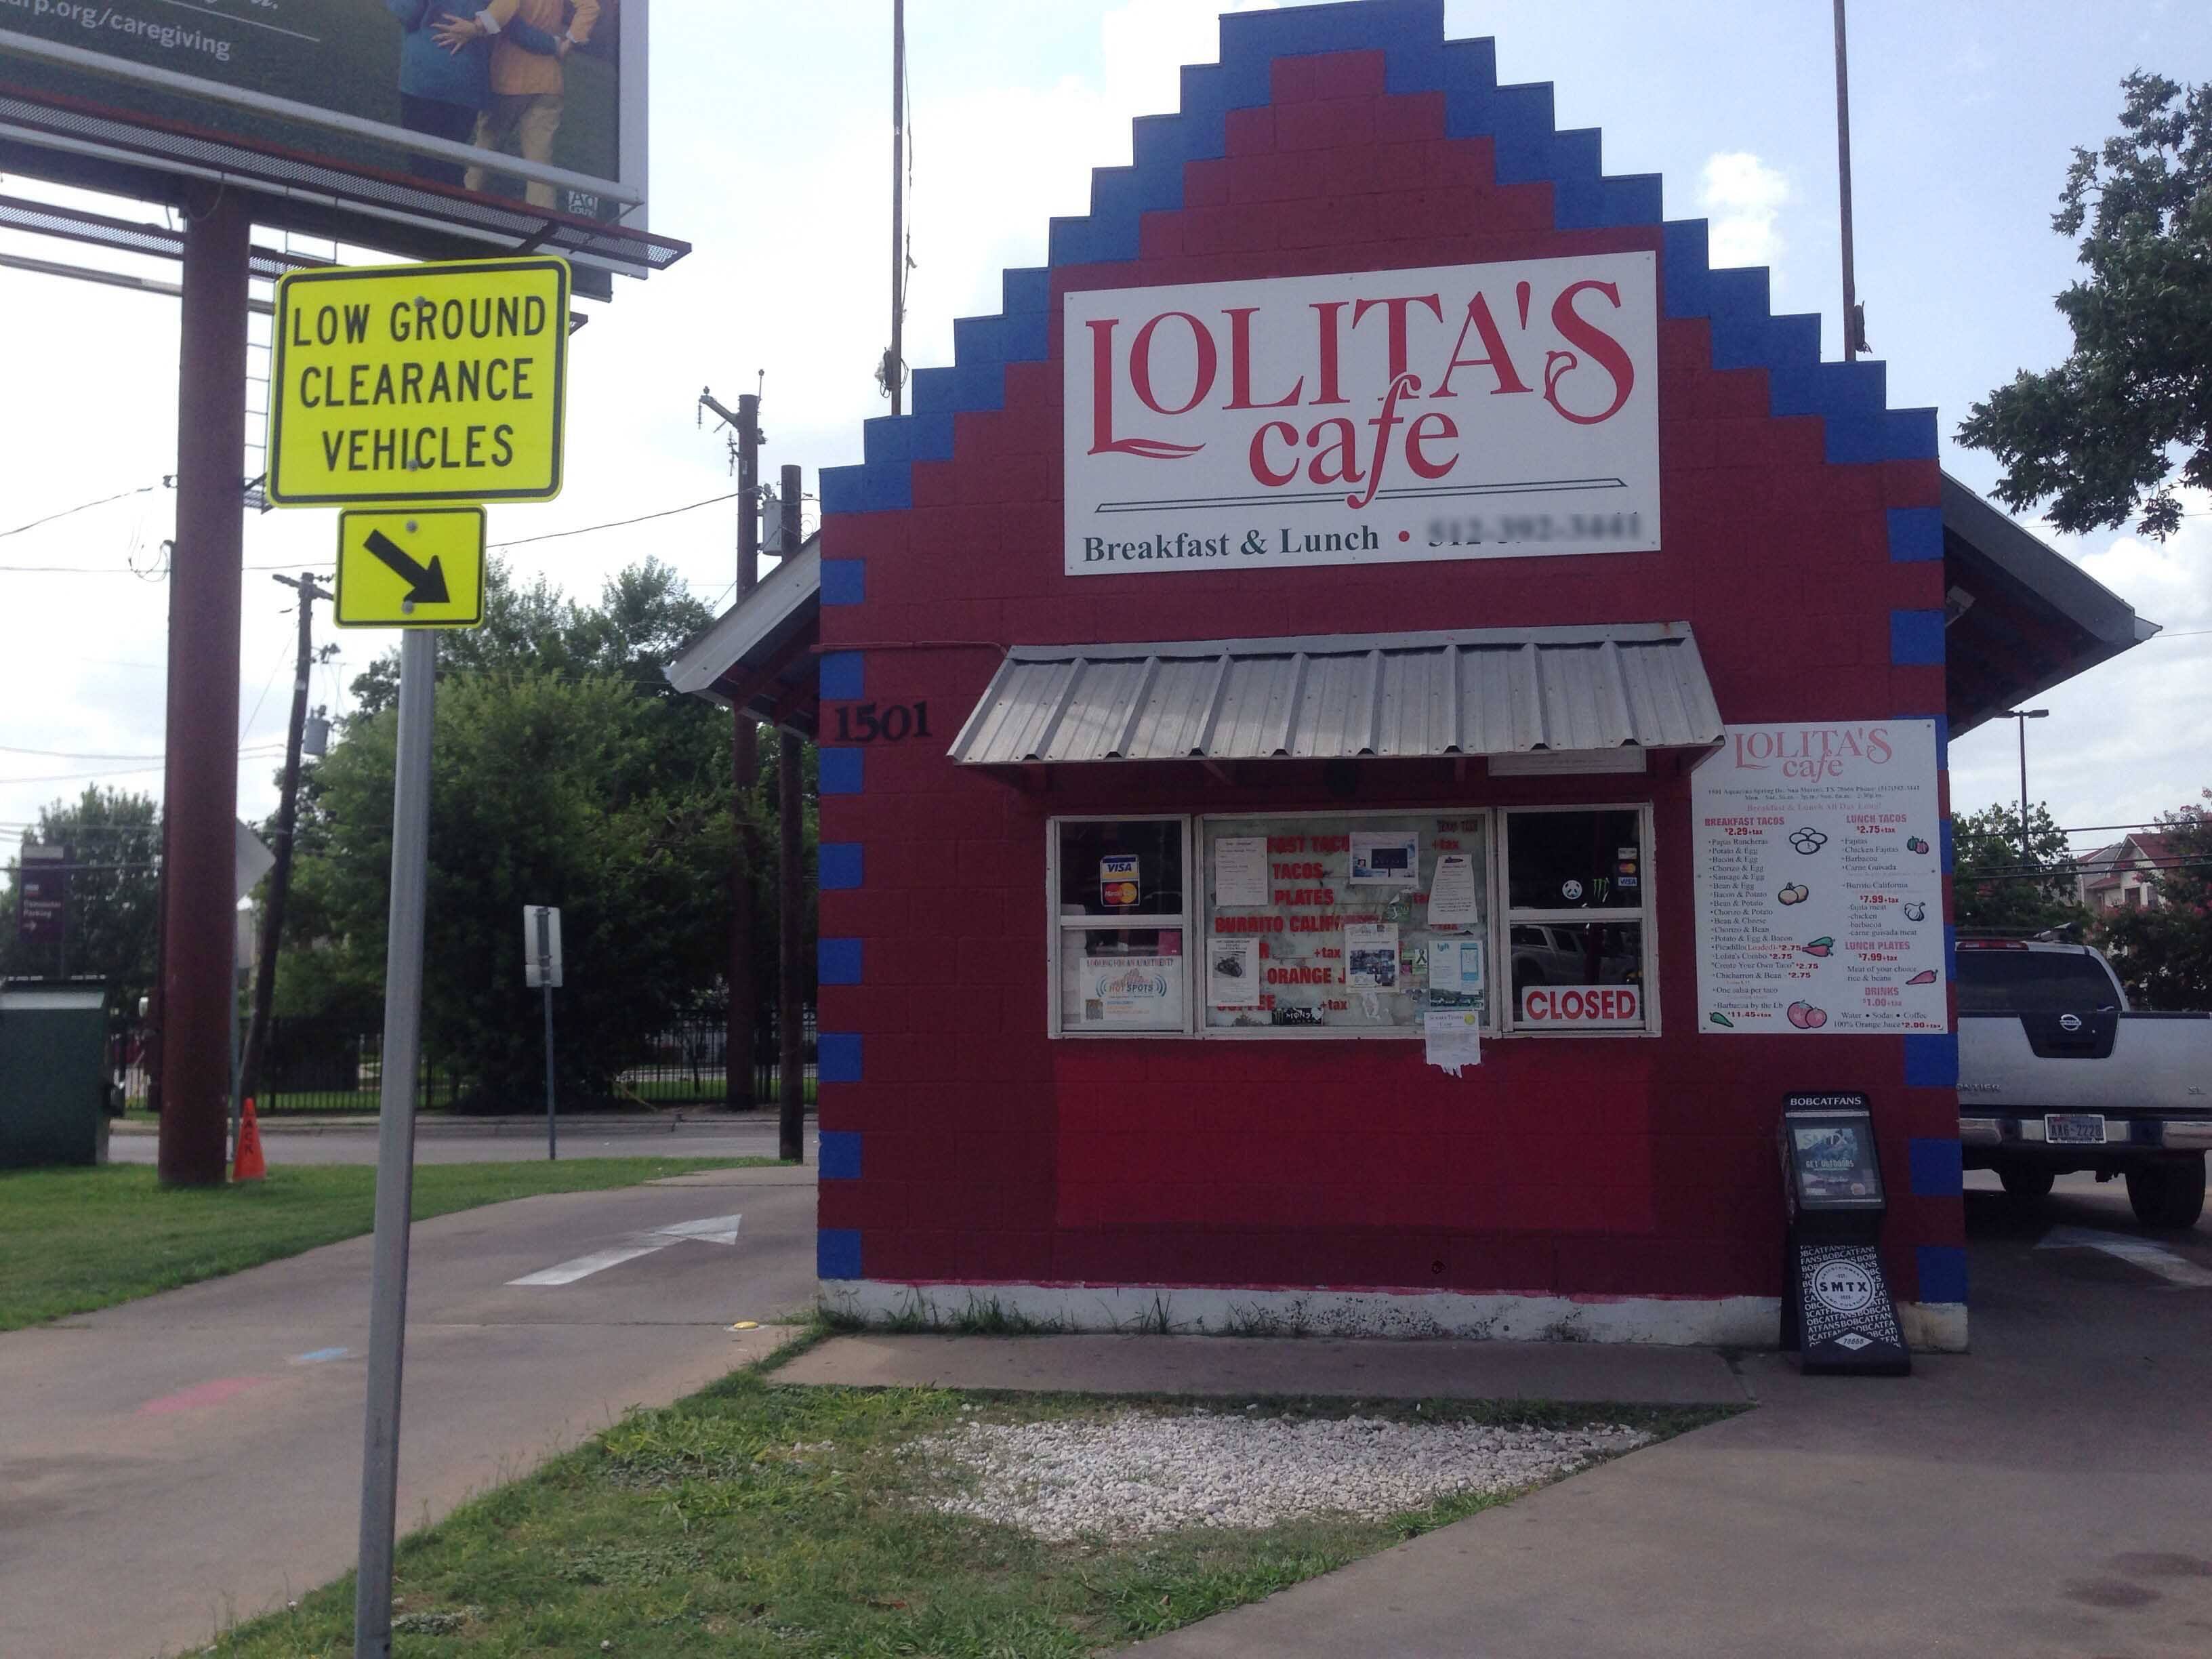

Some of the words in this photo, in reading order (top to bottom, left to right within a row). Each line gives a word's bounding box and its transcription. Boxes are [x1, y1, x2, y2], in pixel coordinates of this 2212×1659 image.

[0, 0, 232, 62] rp.org/caregiving
[293, 304, 371, 346] LOW
[390, 295, 546, 343] GROUND
[1086, 280, 1635, 459] LOLITA'S
[300, 358, 534, 408] CLEARANCE
[322, 424, 514, 472] VEHICLES
[1248, 373, 1460, 509] cafe
[1083, 532, 1230, 562] Breakfast
[1240, 529, 1267, 556] &
[1279, 525, 1380, 554] Lunch
[834, 701, 933, 743] 1501
[1734, 727, 1892, 770] LOLITA'S
[1782, 748, 1844, 783] cafe
[1704, 817, 1755, 827] BREAKFAST
[1757, 817, 1785, 825] TACOS
[1846, 815, 1877, 823] LUNCH
[1879, 814, 1907, 823] TACOS
[1107, 863, 1132, 872] VISA
[1272, 862, 1324, 880] TACOS
[1273, 888, 1334, 906] PLATES
[1214, 916, 1284, 933] BURRITO
[1313, 947, 1341, 958] +tax
[1845, 941, 1875, 949] LUNCH
[1877, 941, 1910, 949] PLATES
[1267, 967, 1332, 984] ORANGE
[1876, 966, 1892, 975] your
[1126, 983, 1153, 993] SPOTS
[1865, 987, 1900, 996] DRINKS
[1319, 999, 1348, 1010] +tax
[1525, 989, 1636, 1021] CLOSED
[1855, 1020, 1881, 1029] Orange
[1790, 1097, 1862, 1106] BOBCATFANS
[1819, 1282, 1868, 1292] SMTX
[1858, 1304, 1891, 1317] BOBCAT
[1841, 1313, 1893, 1327] BOBCATFAN
